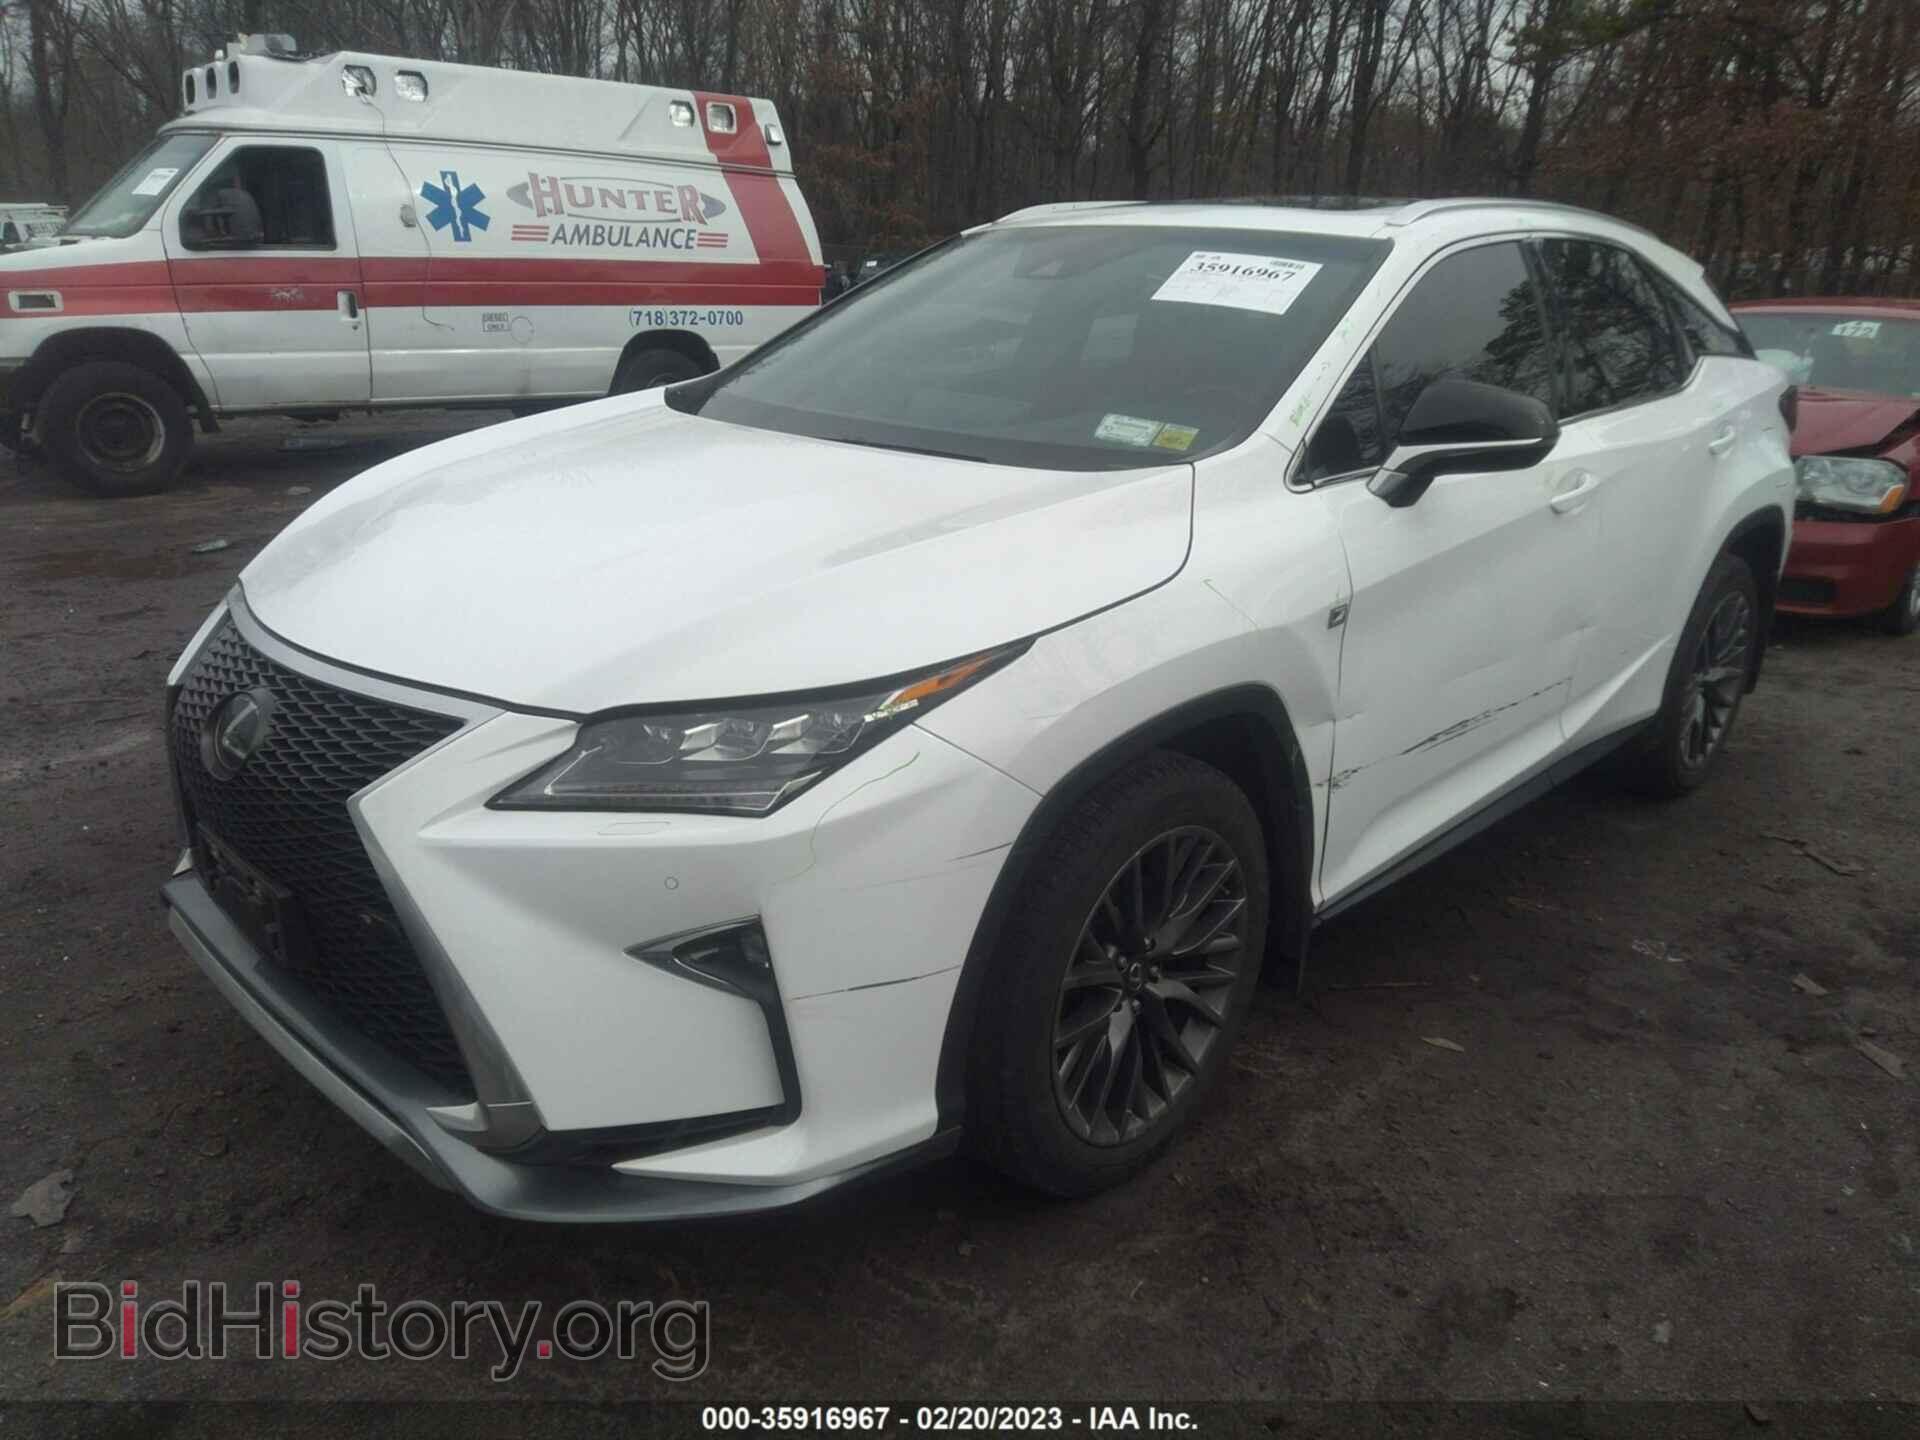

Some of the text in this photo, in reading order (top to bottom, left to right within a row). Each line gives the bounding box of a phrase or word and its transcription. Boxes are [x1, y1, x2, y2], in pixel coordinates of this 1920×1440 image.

[527, 171, 708, 226] HUNTER
[551, 223, 697, 250] AMBULANCE
[1189, 261, 1296, 281] 35916967
[628, 308, 744, 329] (718)372-0700
